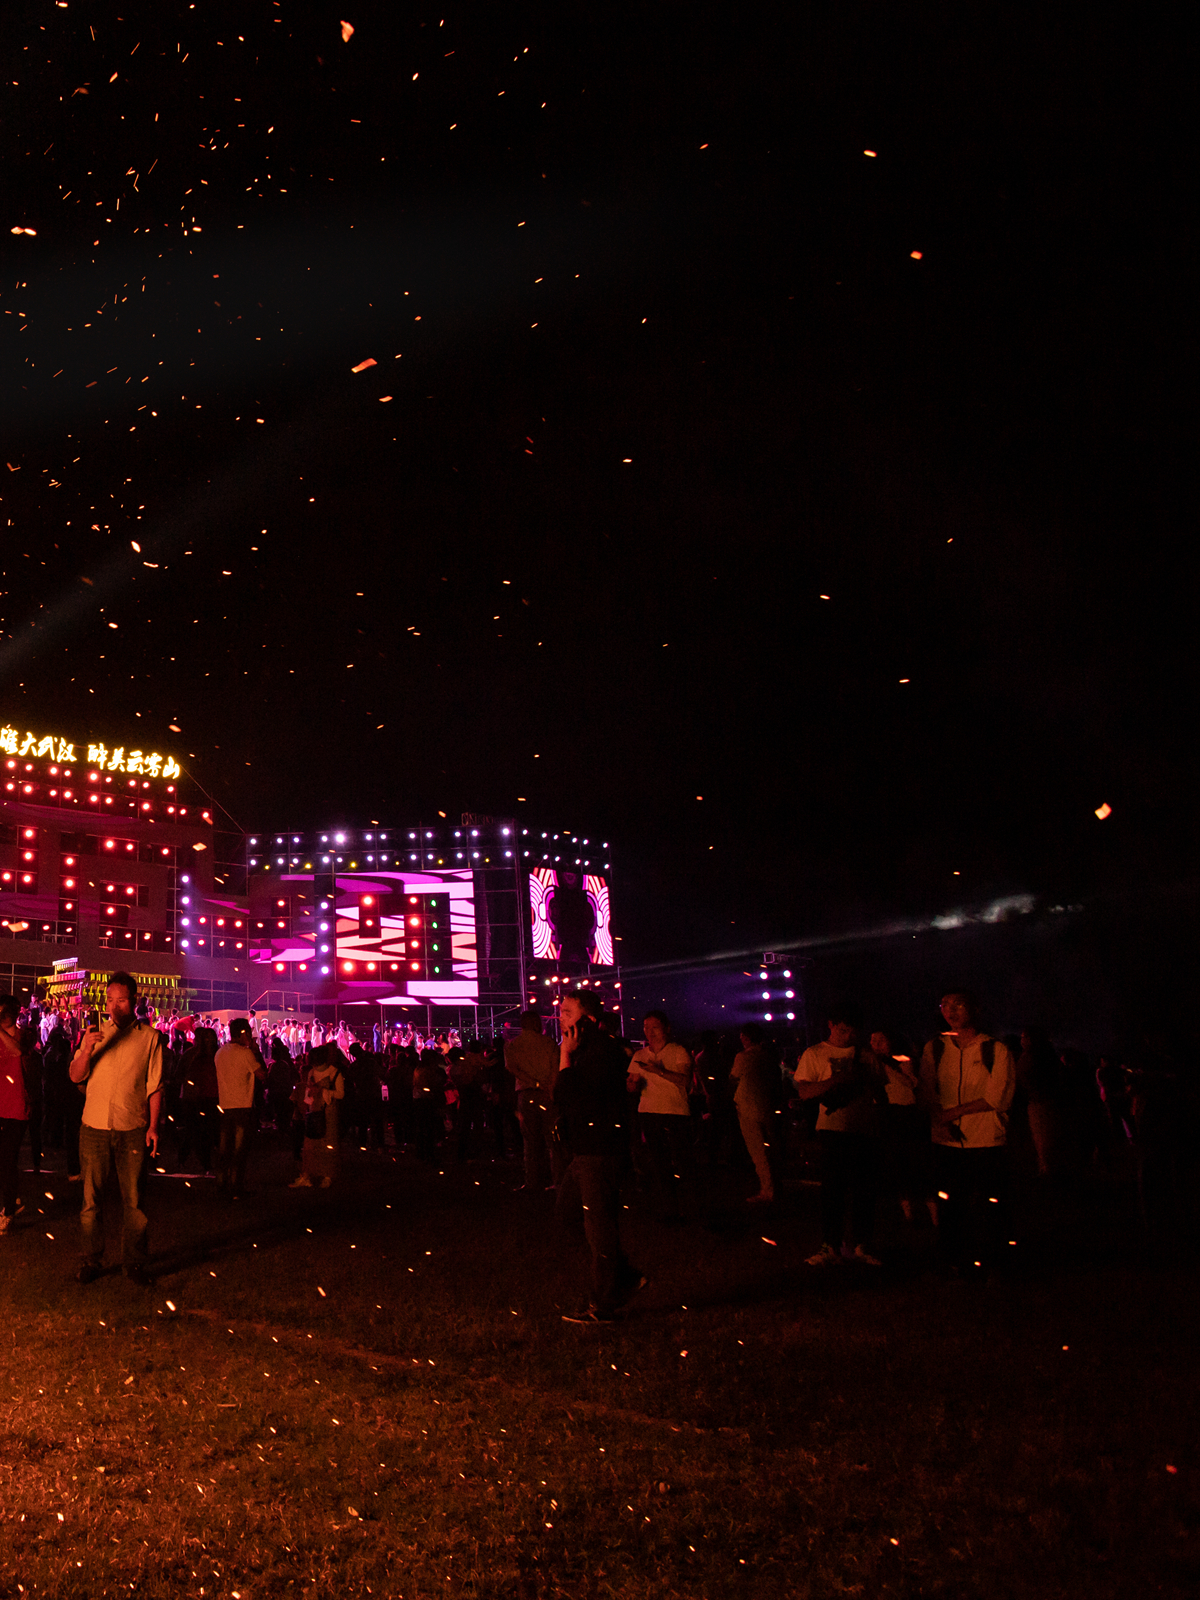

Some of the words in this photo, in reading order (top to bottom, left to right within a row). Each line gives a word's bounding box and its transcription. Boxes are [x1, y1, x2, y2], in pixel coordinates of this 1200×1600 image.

[87, 742, 182, 780] 醉美云雾山
